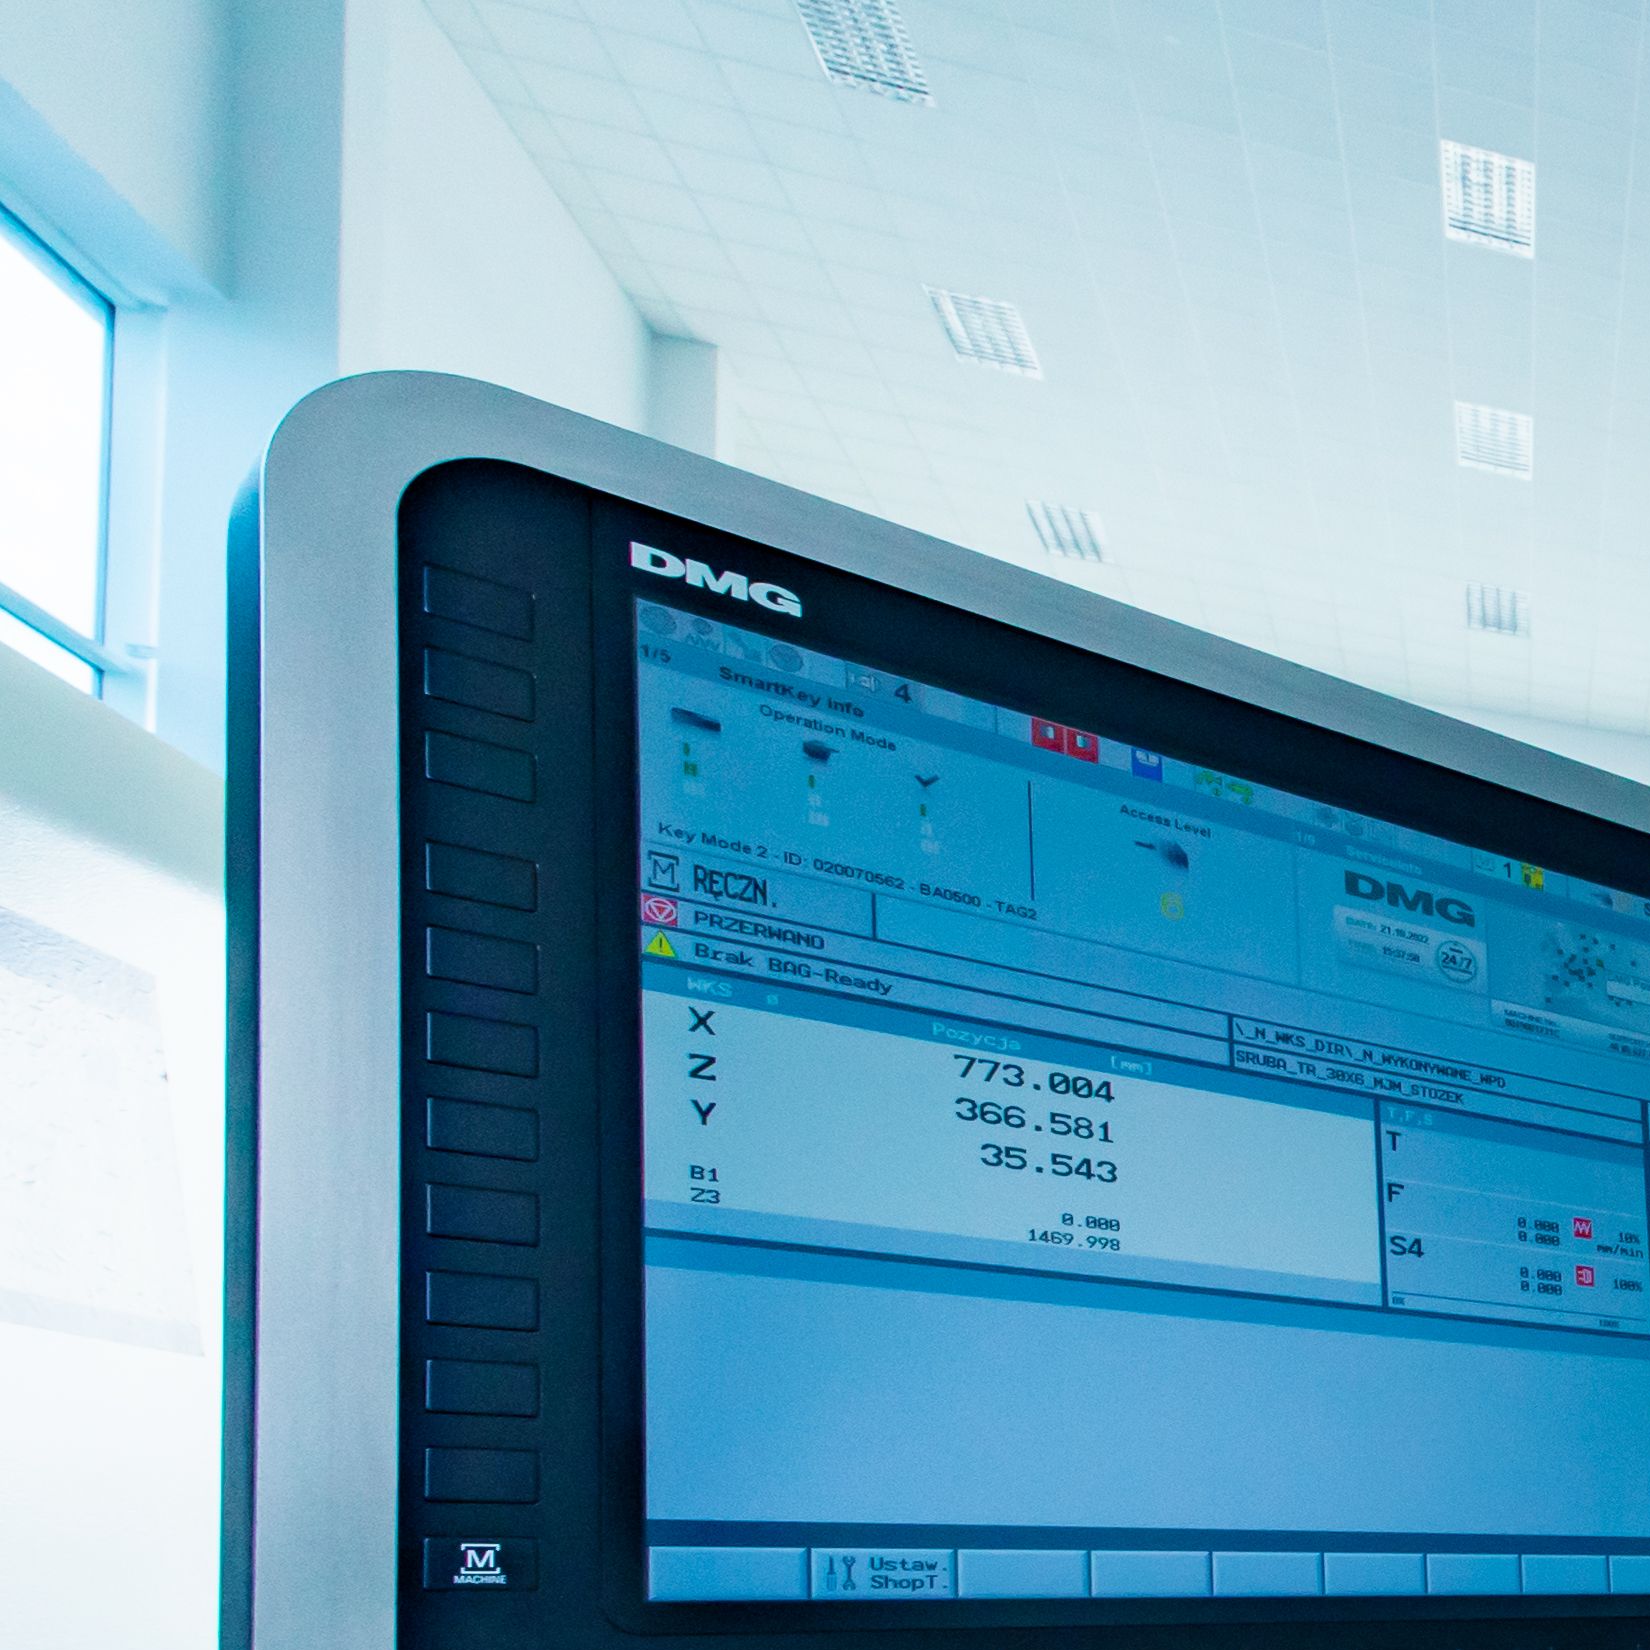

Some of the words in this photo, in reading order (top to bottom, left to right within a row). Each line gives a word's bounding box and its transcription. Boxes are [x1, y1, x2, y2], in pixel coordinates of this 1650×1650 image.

[629, 542, 803, 617] DMG
[720, 667, 820, 708] SmartKey
[829, 697, 864, 718] Info
[895, 683, 912, 703] 4
[759, 704, 845, 738] Operation
[851, 730, 896, 751] Mode
[1120, 804, 1171, 827] Access
[1175, 818, 1212, 839] Level
[658, 822, 694, 843] Key
[701, 833, 750, 853] Mode
[756, 845, 768, 859] 2
[996, 901, 1037, 920] TAG2
[693, 864, 778, 908] RĘCZN.
[1503, 862, 1512, 879] 1
[1344, 870, 1476, 928] DMG
[694, 911, 825, 949] PRZERWANO
[694, 943, 754, 968] Brak
[768, 957, 893, 995] BAG-Ready
[1441, 952, 1473, 970] 24/7
[932, 1022, 1022, 1051] Pozycja
[687, 1006, 717, 1036] X
[953, 1053, 1116, 1102] 773.004
[687, 1053, 718, 1081] Z
[954, 1096, 1116, 1143] 366.581
[690, 1099, 718, 1127] Y
[980, 1142, 1119, 1184] 35.543
[1386, 1130, 1401, 1151] T
[689, 1165, 719, 1183] B1
[689, 1187, 721, 1204] Z3
[1387, 1182, 1404, 1202] F
[1389, 1235, 1424, 1258] S4
[453, 1574, 507, 1585] MACHINE
[870, 1554, 948, 1574] Ustaw.
[870, 1573, 948, 1594] ShopT.
